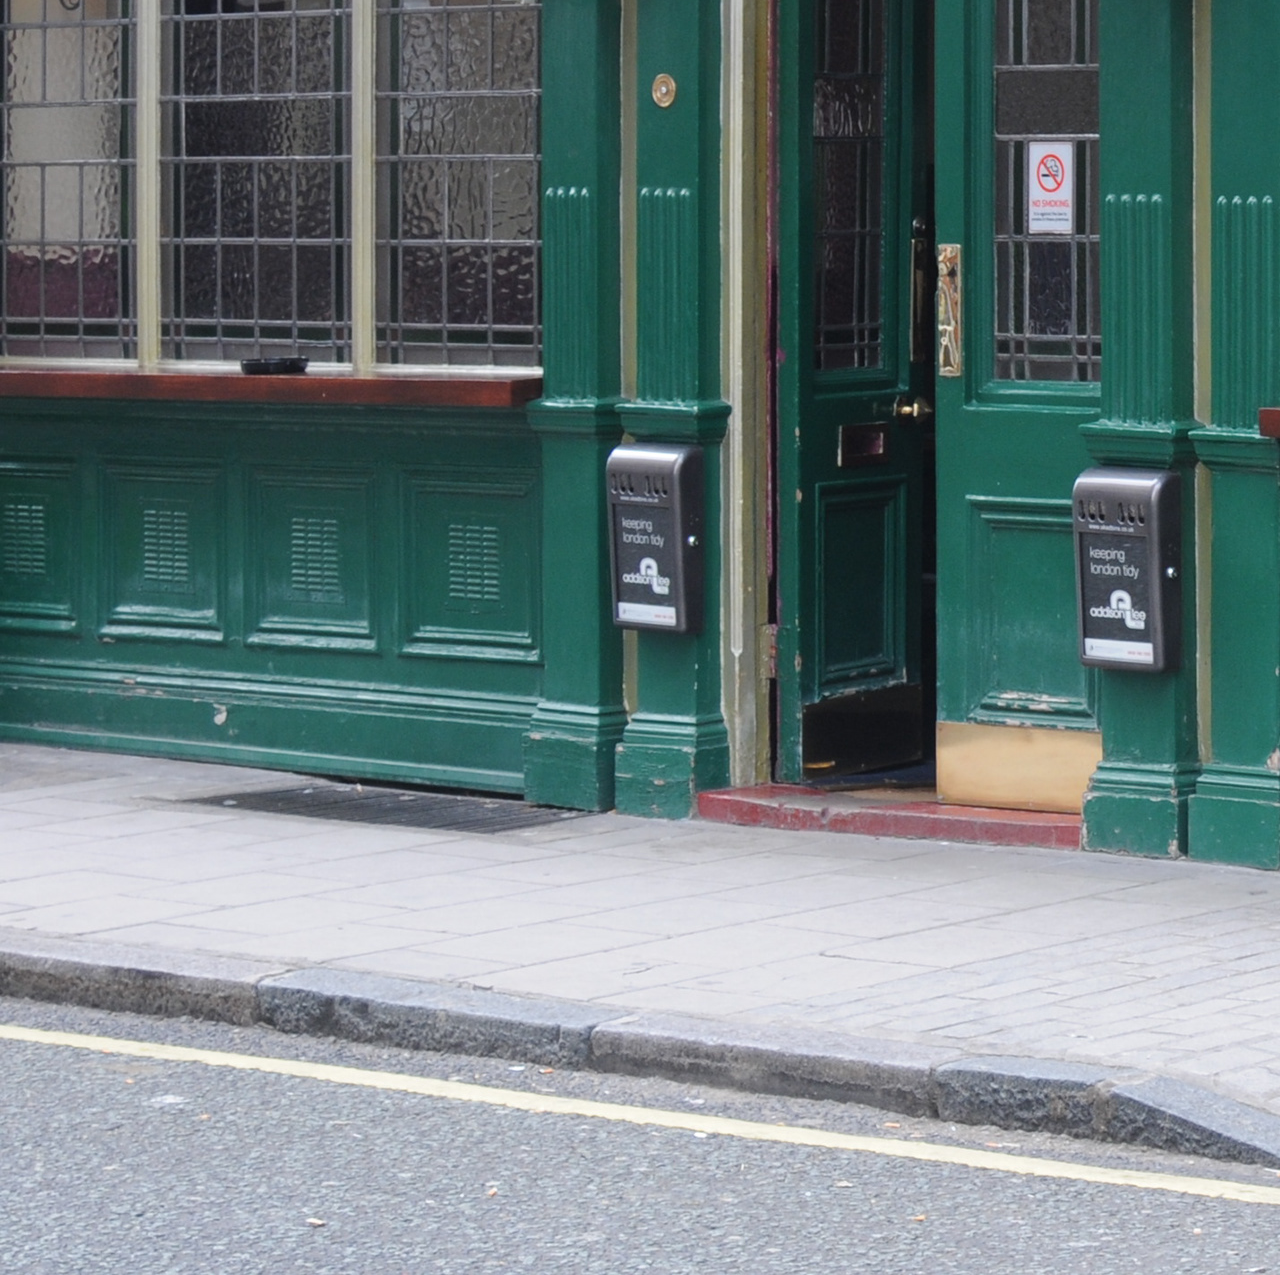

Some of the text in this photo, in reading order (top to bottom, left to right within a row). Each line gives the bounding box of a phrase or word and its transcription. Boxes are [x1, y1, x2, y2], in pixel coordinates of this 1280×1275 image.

[622, 517, 653, 534] keeping
[623, 532, 664, 548] london tidy
[1089, 546, 1125, 563] keeping
[1090, 562, 1139, 580] london tidy
[622, 572, 671, 587] addison lee
[1089, 605, 1147, 621] addison lee
